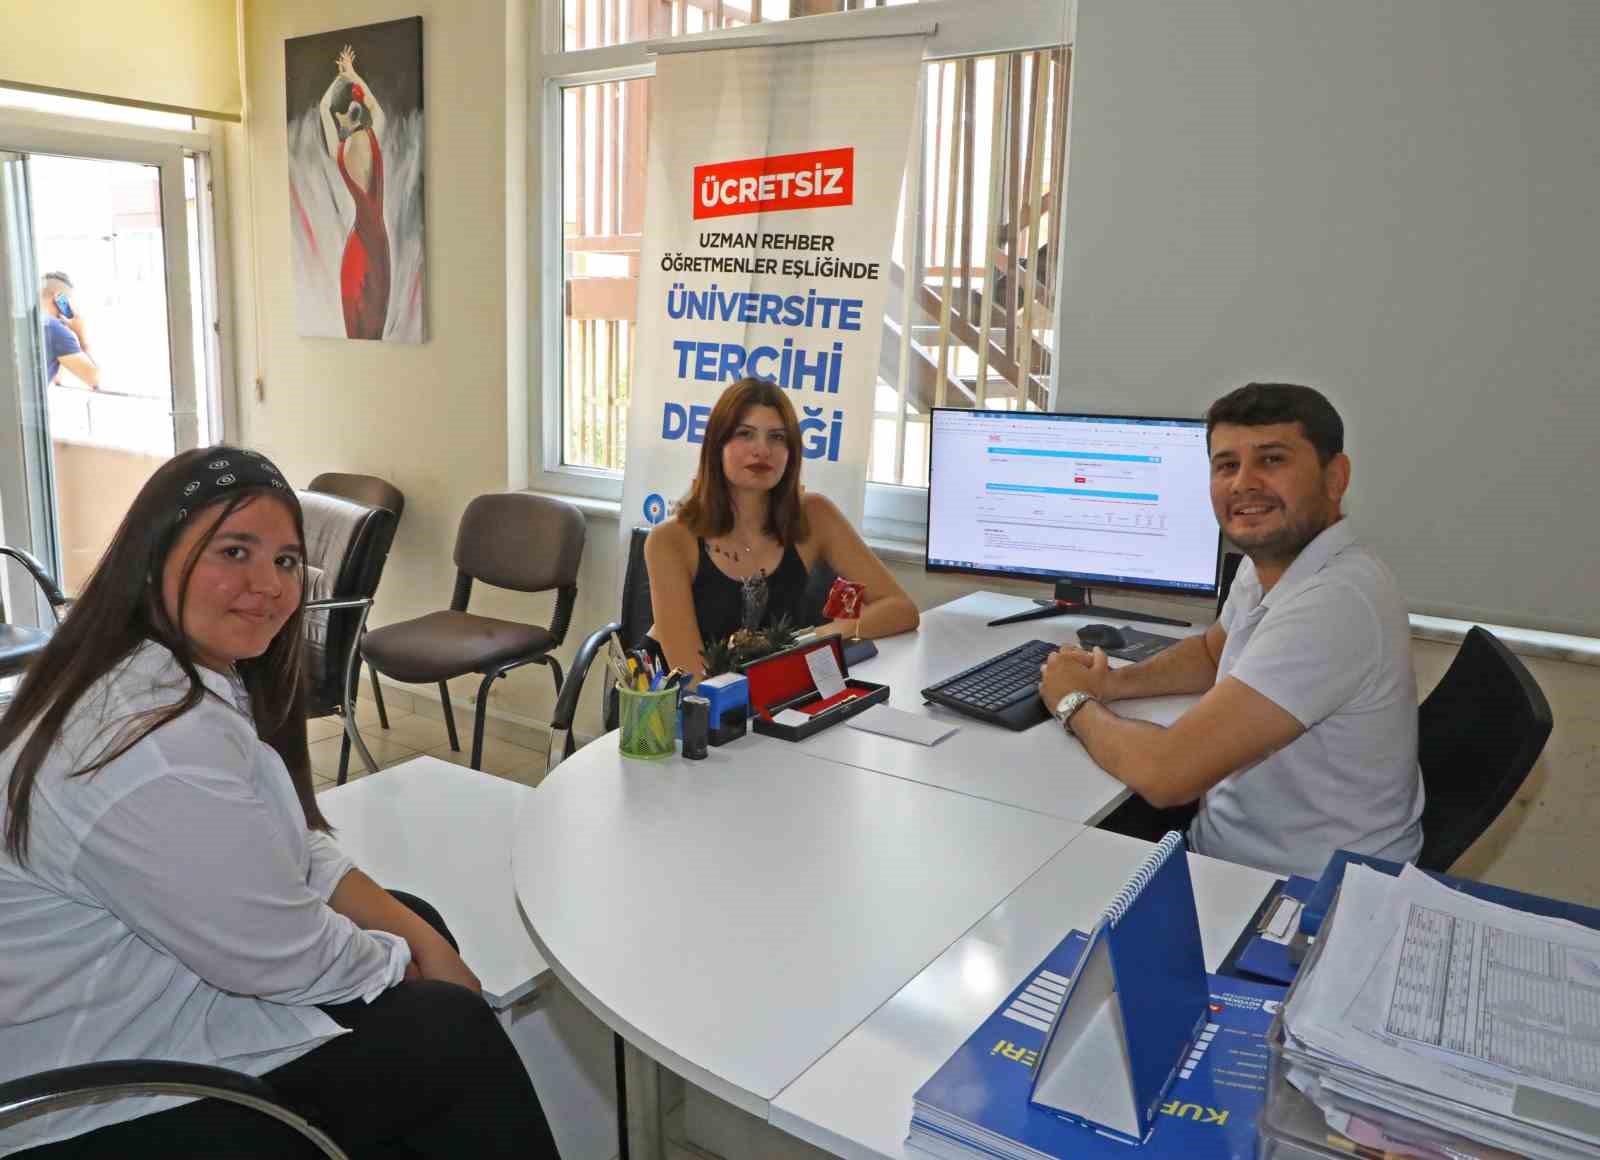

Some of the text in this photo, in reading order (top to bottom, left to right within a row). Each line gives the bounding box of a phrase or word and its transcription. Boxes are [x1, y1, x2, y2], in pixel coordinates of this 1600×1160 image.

[701, 163, 844, 207] ÜCRETSİZ
[699, 232, 835, 251] UZMAN REHBER
[660, 253, 880, 280] ÖĞRETMENLER EŞLİĞİNDE
[667, 283, 864, 331] ÜNİVERSİTE
[673, 338, 844, 394] TERCİHİ
[661, 402, 844, 462] DEĞİ
